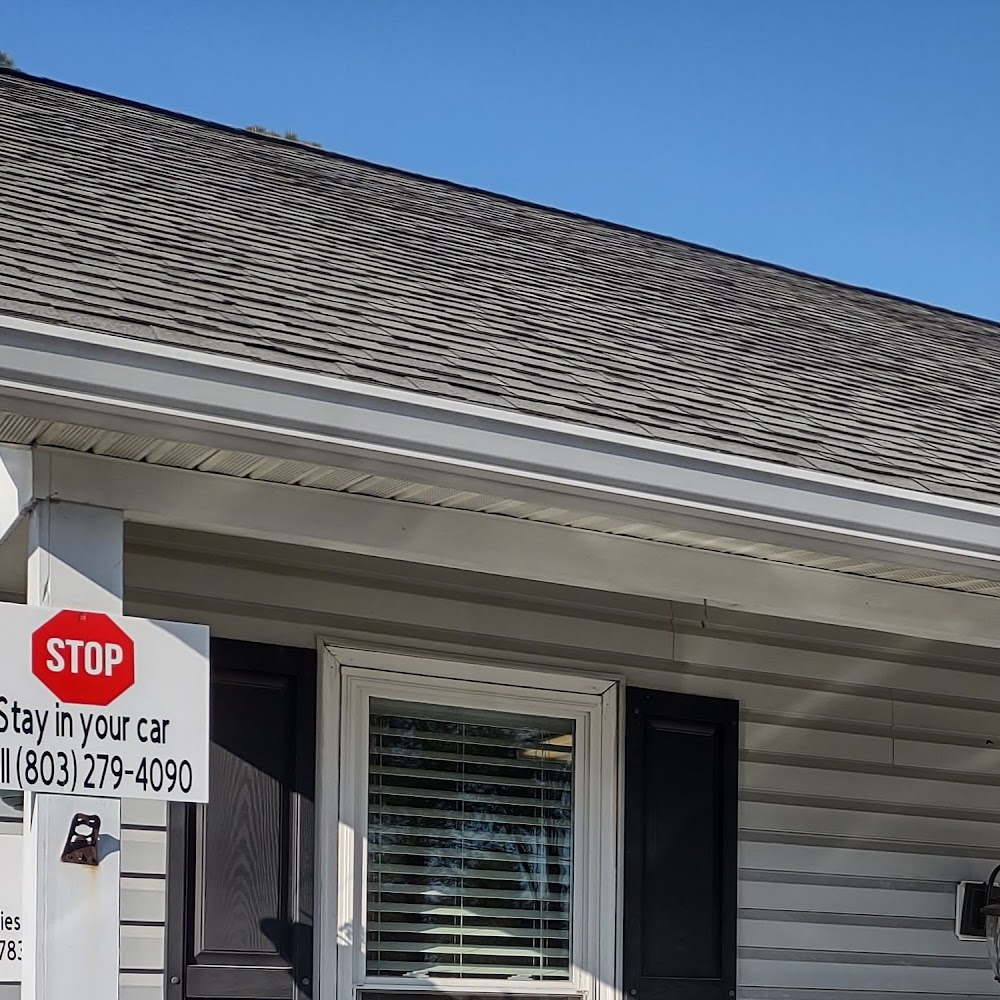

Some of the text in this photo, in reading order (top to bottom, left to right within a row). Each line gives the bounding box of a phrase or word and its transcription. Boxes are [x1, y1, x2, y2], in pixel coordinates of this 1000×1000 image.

[46, 637, 123, 677] STOP
[0, 696, 170, 749] Stay in your car
[1, 746, 193, 794] ll (803) 279-4090
[1, 911, 21, 931] ies
